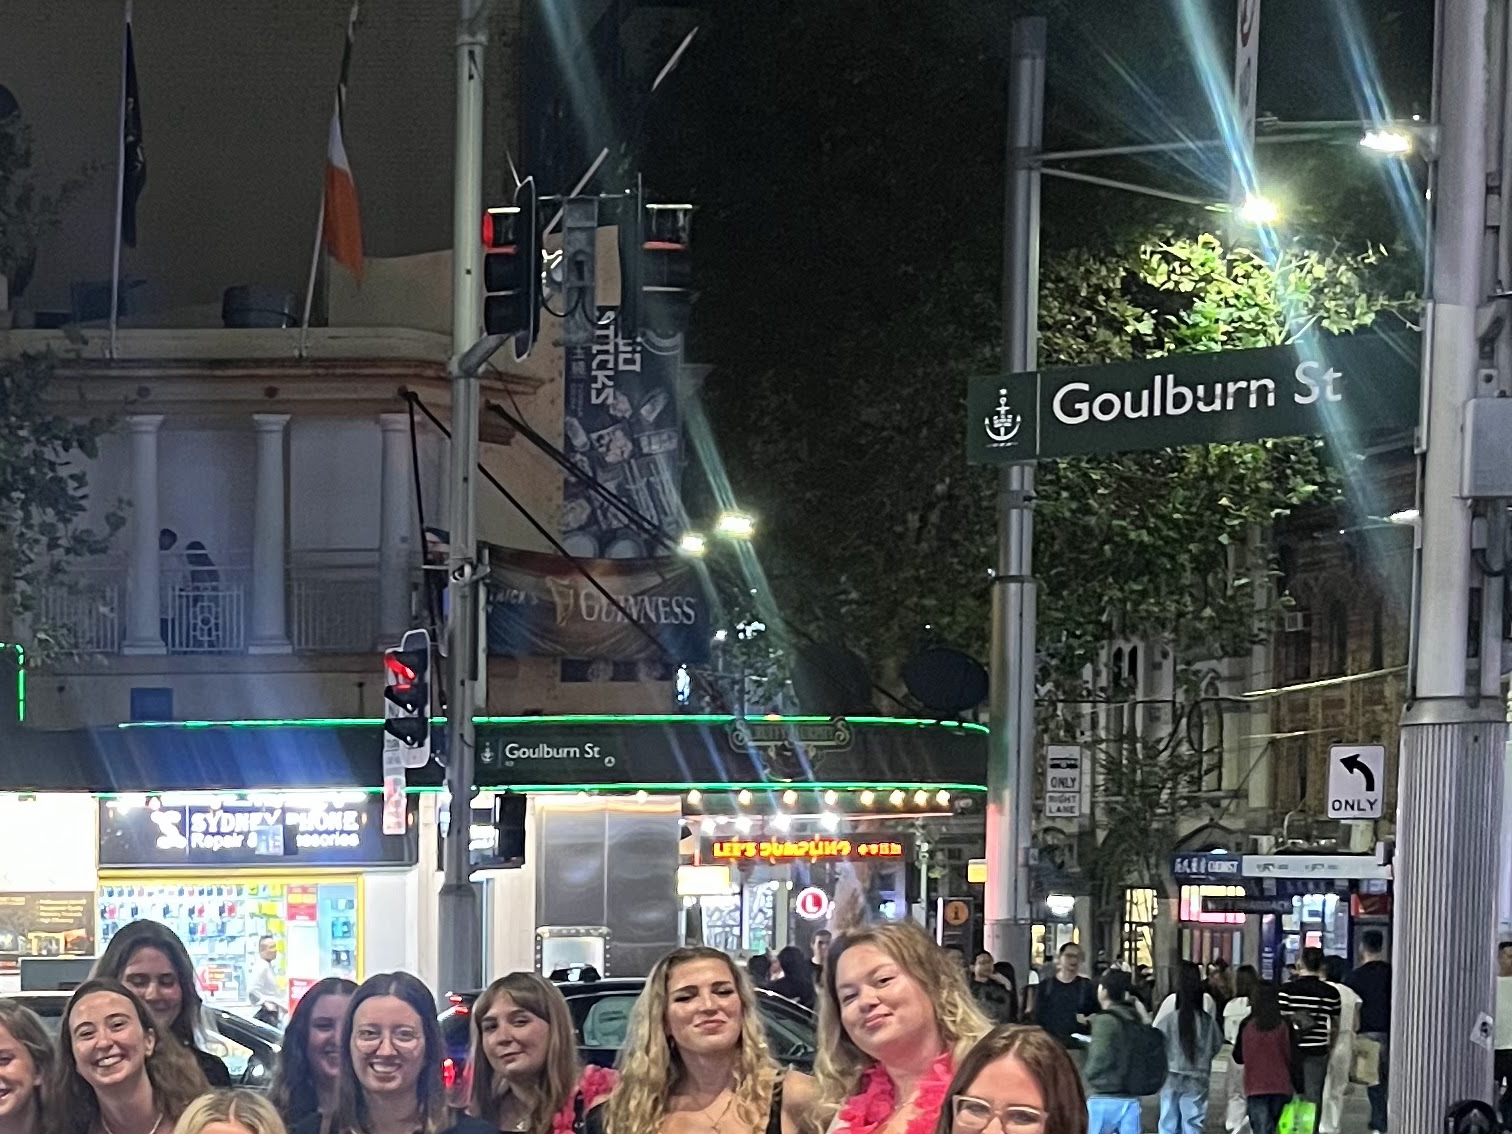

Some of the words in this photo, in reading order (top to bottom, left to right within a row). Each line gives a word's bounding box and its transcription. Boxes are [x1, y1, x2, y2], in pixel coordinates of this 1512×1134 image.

[1052, 373, 1275, 425] Goulburn
[1294, 361, 1343, 405] St
[580, 589, 696, 625] GUINNESS
[505, 743, 580, 759] Goulburn
[584, 742, 601, 759] St
[1051, 776, 1076, 788] ONLY
[1048, 805, 1076, 814] LANE
[1331, 798, 1378, 811] ONLY
[191, 809, 281, 833] SYDNEY
[286, 811, 360, 832] PHONE
[191, 832, 244, 851] Repair
